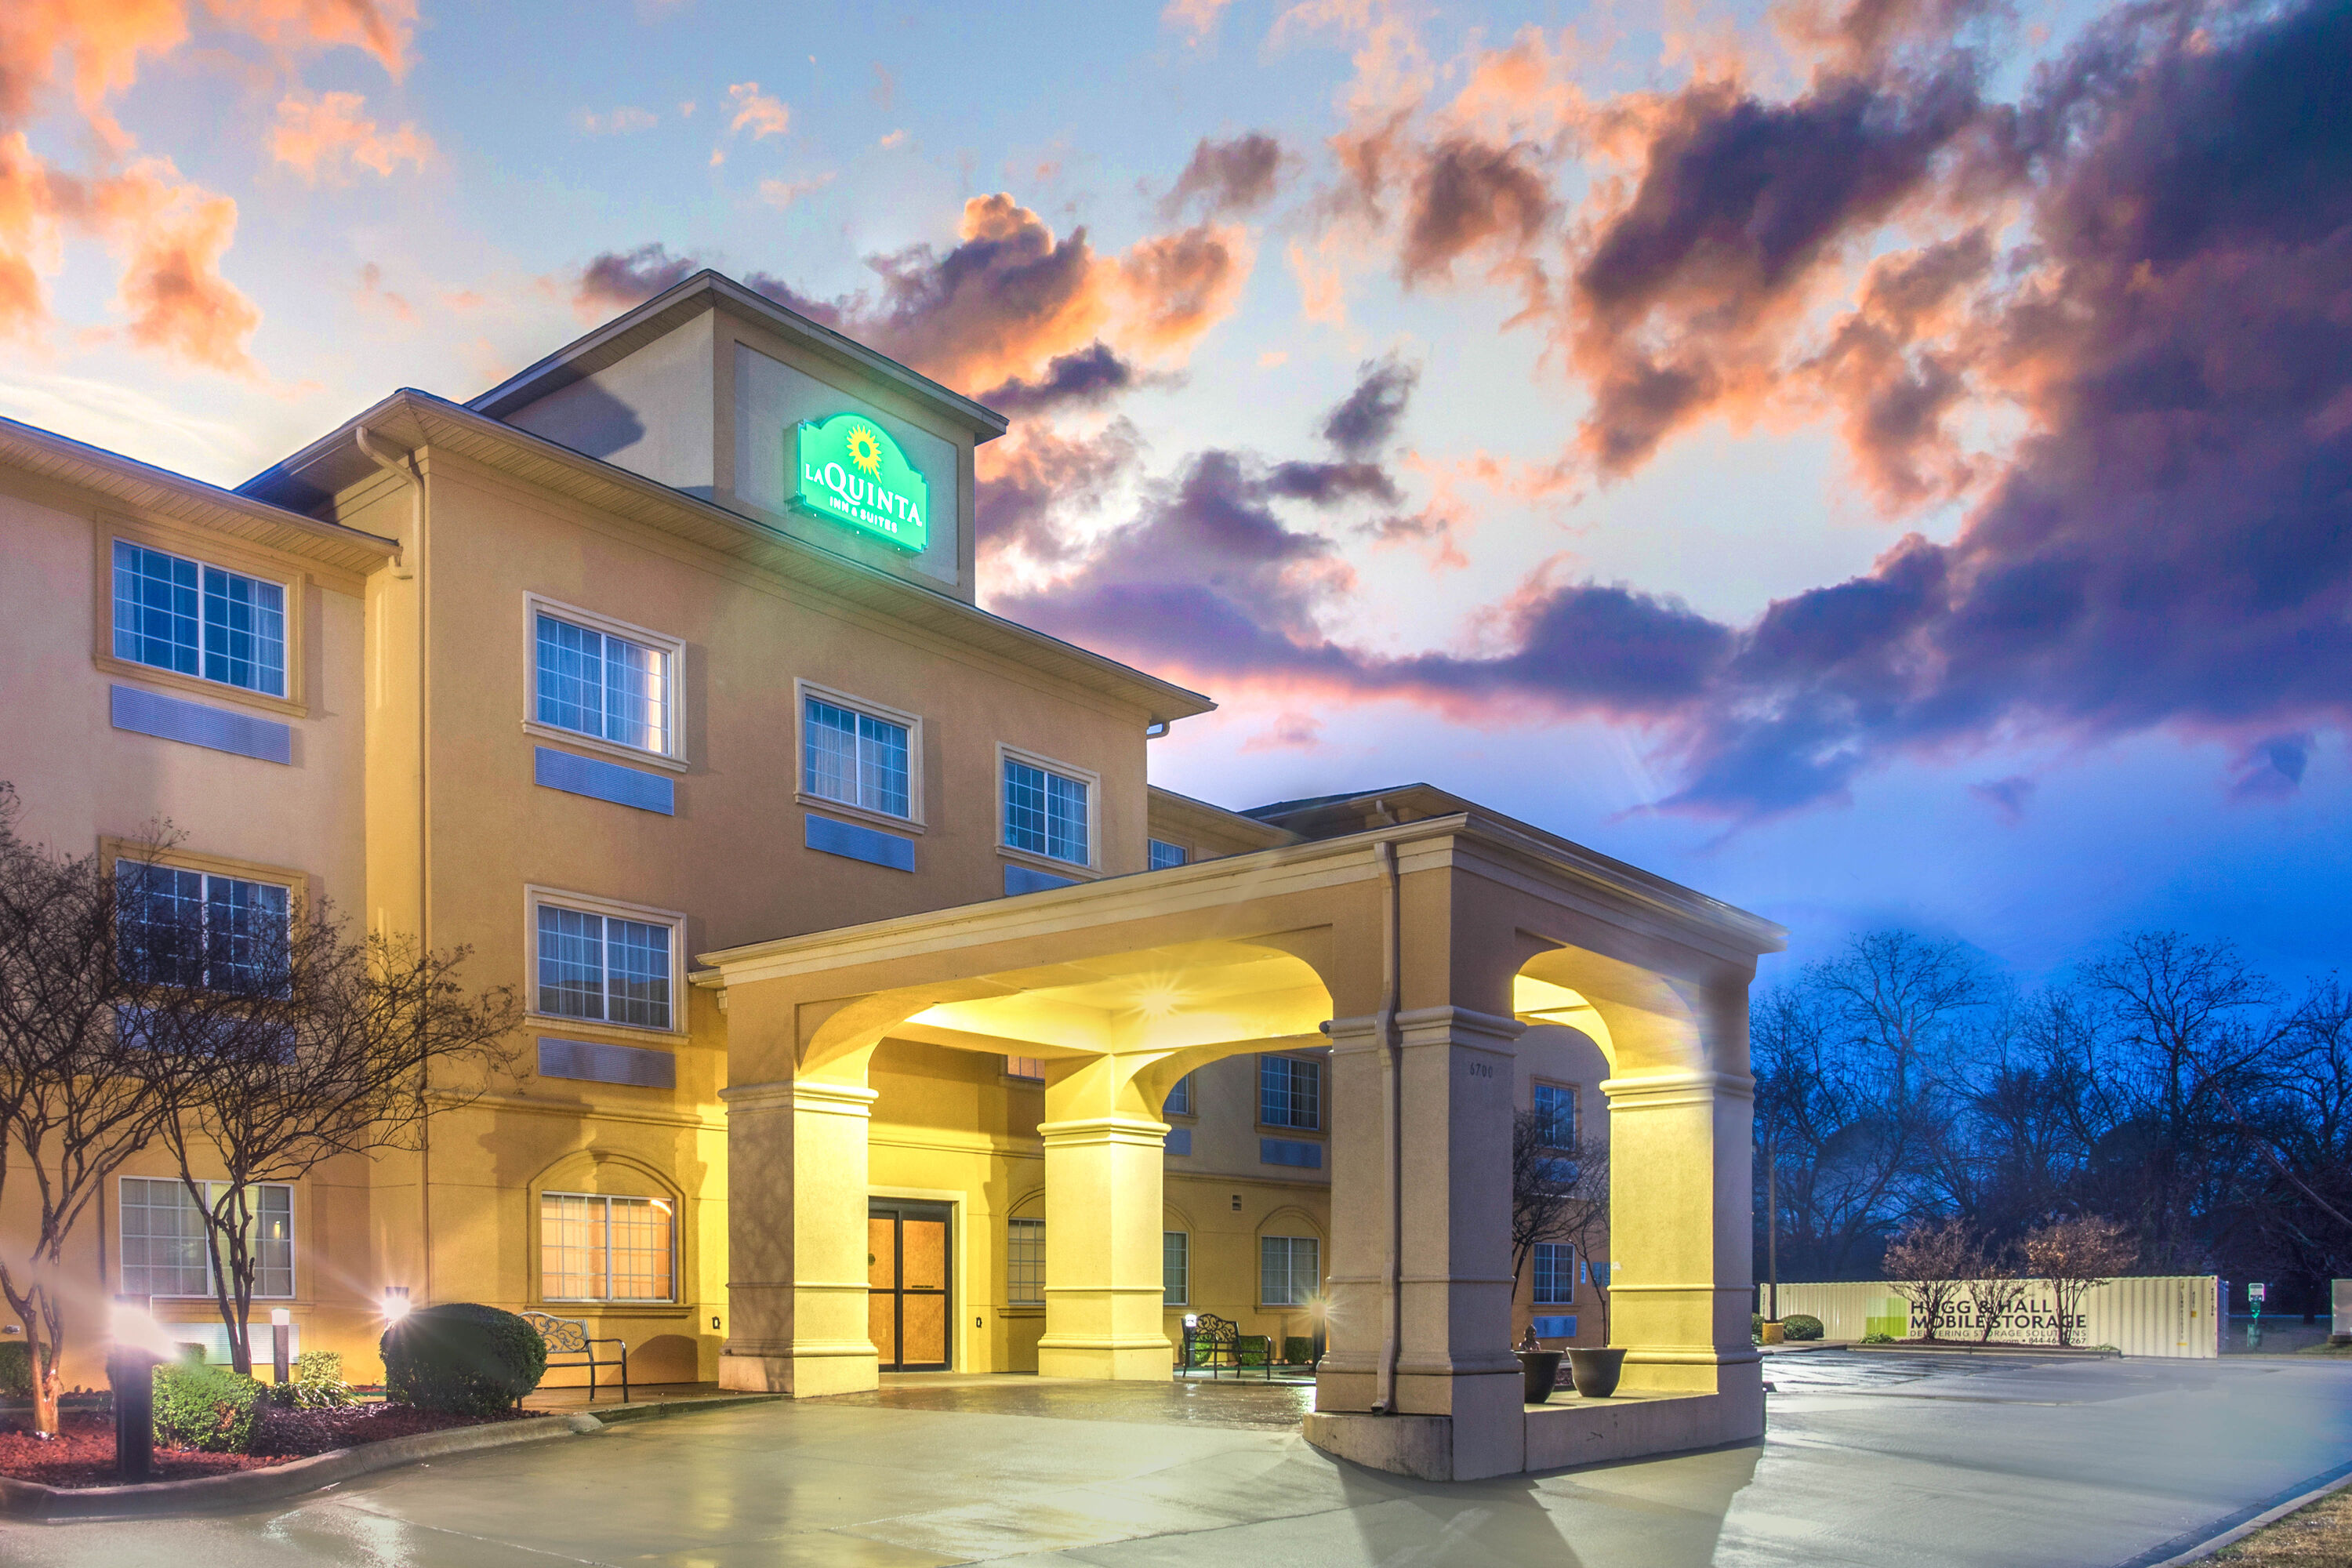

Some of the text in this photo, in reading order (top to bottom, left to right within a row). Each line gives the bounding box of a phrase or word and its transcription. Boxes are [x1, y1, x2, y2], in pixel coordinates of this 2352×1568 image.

[805, 462, 923, 528] LA QUINTA
[829, 496, 850, 513] INN
[859, 509, 898, 533] SUITES
[1470, 1062, 1494, 1079] 6700
[1997, 1299, 2053, 1313] HALL
[1911, 1315, 1986, 1329] MOBILE
